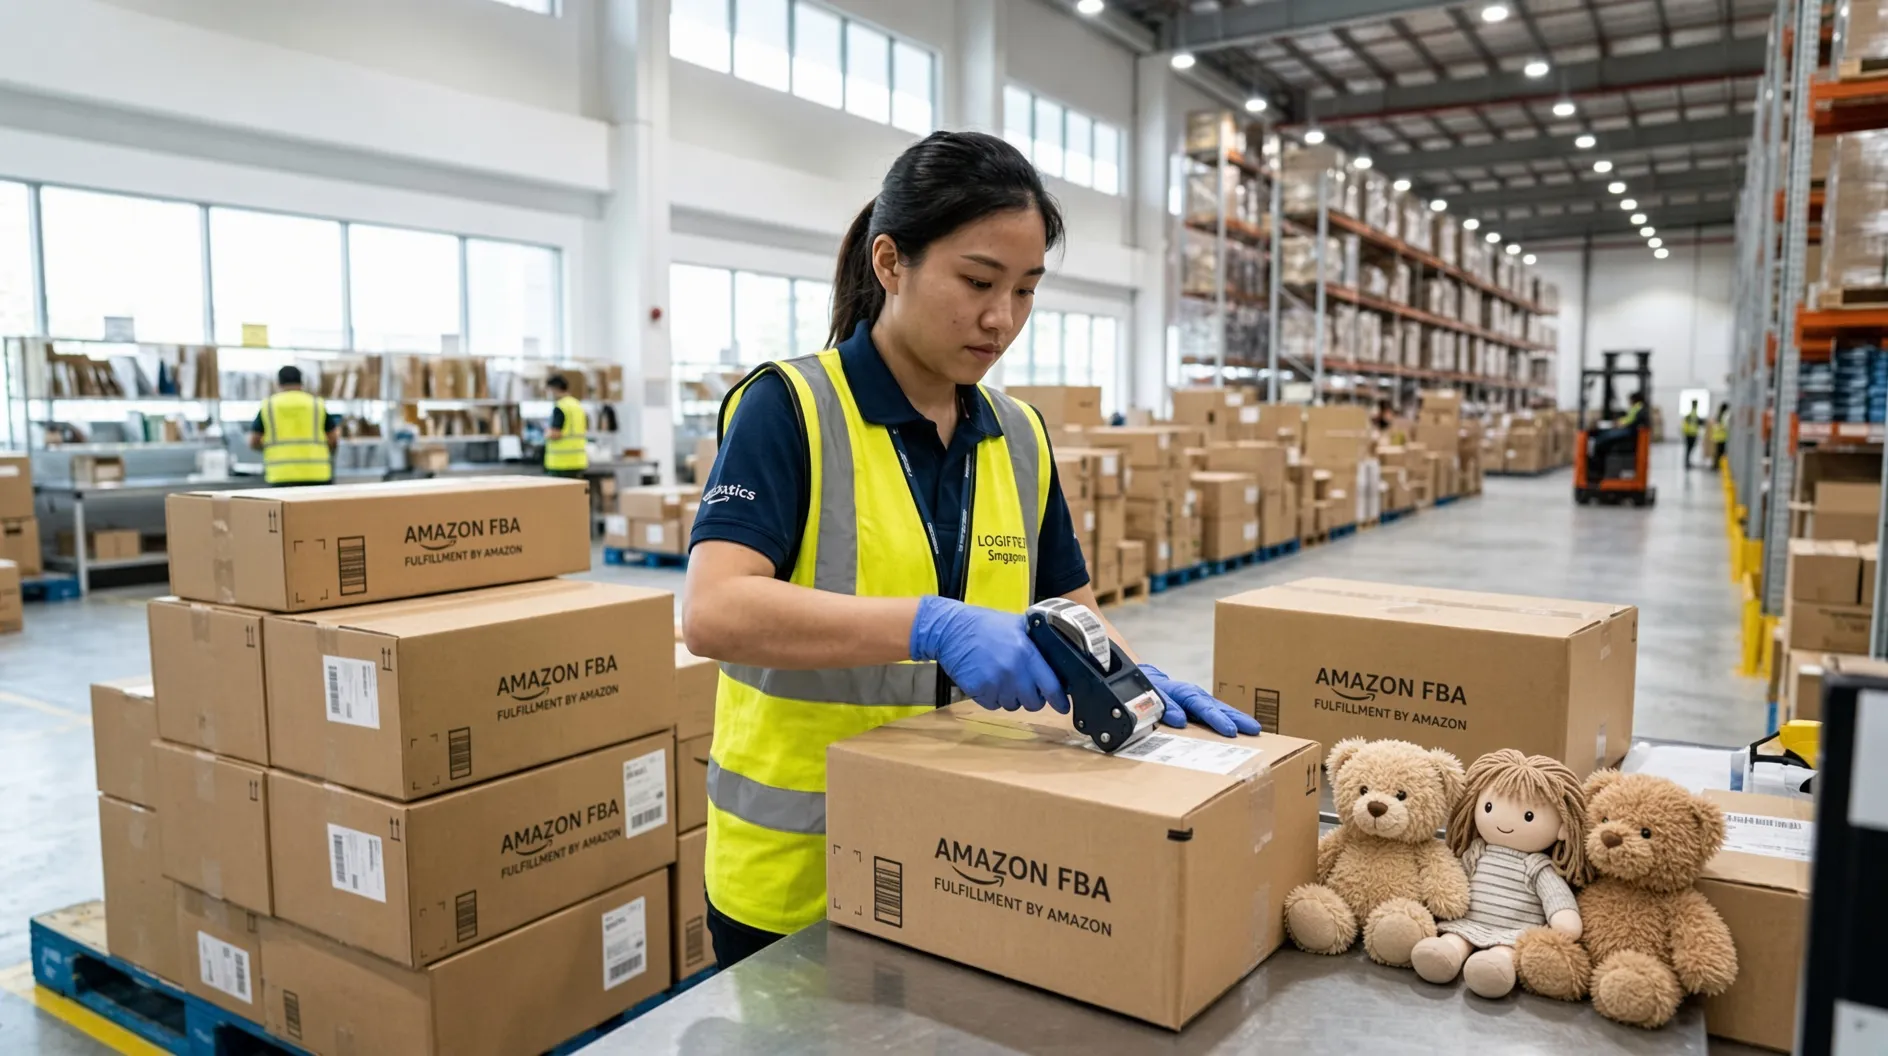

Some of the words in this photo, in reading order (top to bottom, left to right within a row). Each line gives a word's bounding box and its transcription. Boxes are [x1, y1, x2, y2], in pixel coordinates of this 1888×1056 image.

[404, 519, 484, 544] AMAZON
[489, 517, 521, 535] FBA
[404, 550, 468, 567] FULFILLMENT
[470, 549, 482, 560] BY
[484, 545, 523, 558] AMAZON
[497, 661, 579, 696] AMAZON
[585, 654, 618, 677] FBA
[1315, 667, 1414, 698] AMAZON
[1422, 681, 1467, 706] FBA
[497, 696, 563, 721] FULFILLMENT
[565, 693, 578, 706] BY
[579, 684, 619, 702] AMAZON
[1314, 698, 1391, 719] FULFILLMENT
[1394, 710, 1409, 722] BY
[1412, 713, 1467, 731] AMAZON
[501, 810, 582, 854] AMAZON
[587, 799, 620, 824] FBA
[501, 846, 567, 879] FULFILLMENT
[568, 841, 580, 855] BY
[582, 827, 621, 850] AMAZON
[934, 837, 1048, 887] AMAZON
[1057, 866, 1112, 904] FBA
[934, 877, 1022, 912] FULFILLMENT
[1026, 902, 1044, 917] BY
[1047, 908, 1112, 937] AMAZON
